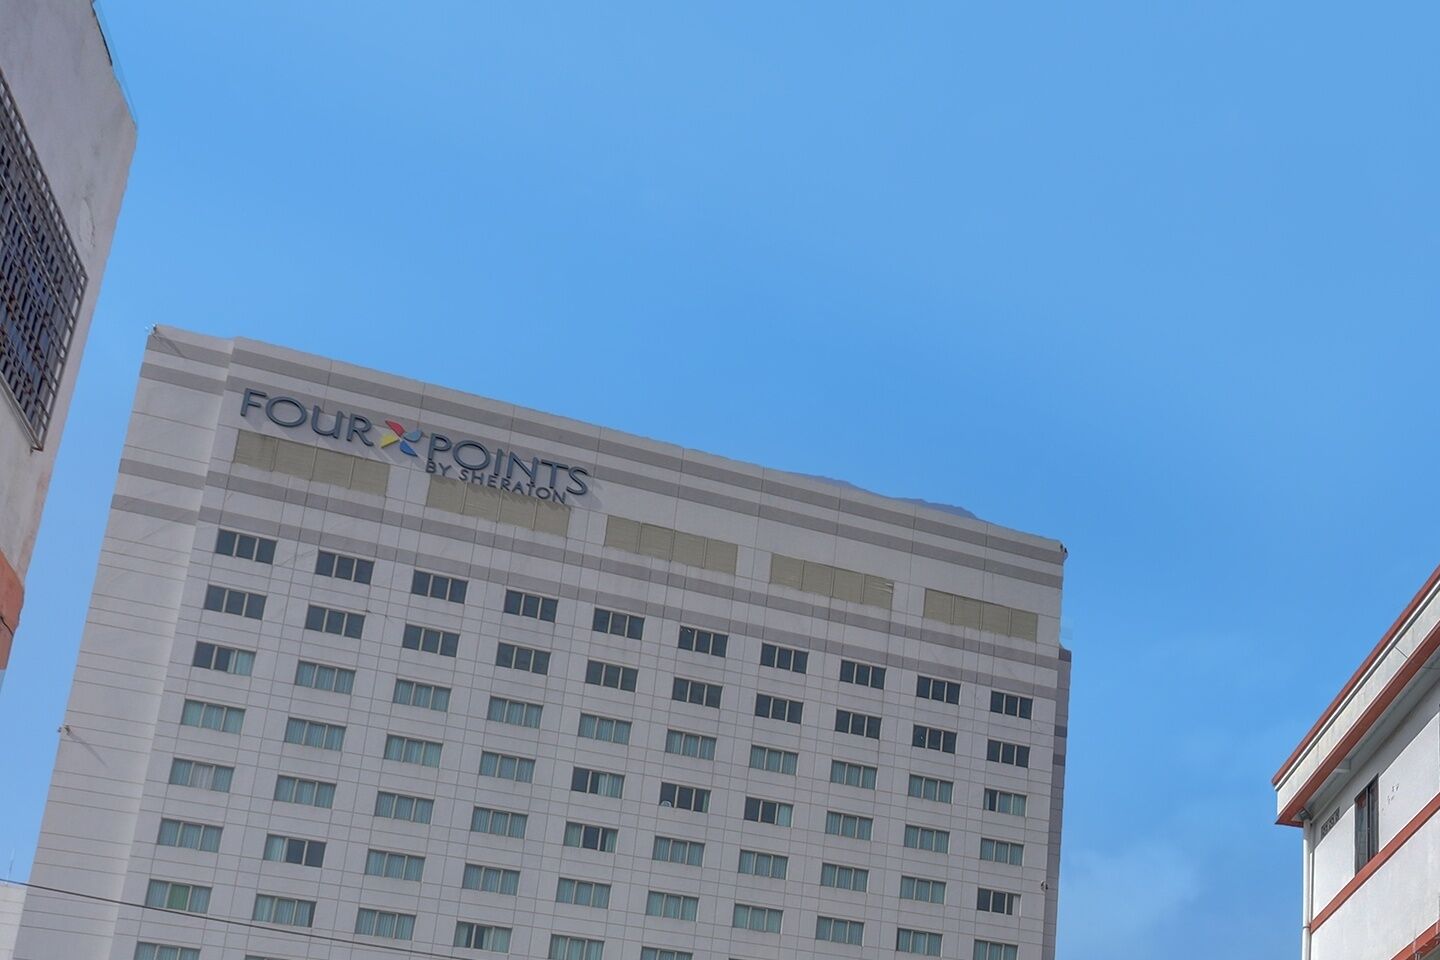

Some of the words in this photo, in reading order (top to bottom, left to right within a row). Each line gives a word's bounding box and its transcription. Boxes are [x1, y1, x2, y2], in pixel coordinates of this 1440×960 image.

[240, 387, 375, 447] FOUR
[427, 432, 588, 496] POINTS
[425, 461, 452, 477] BY
[458, 469, 567, 505] SHERATON
